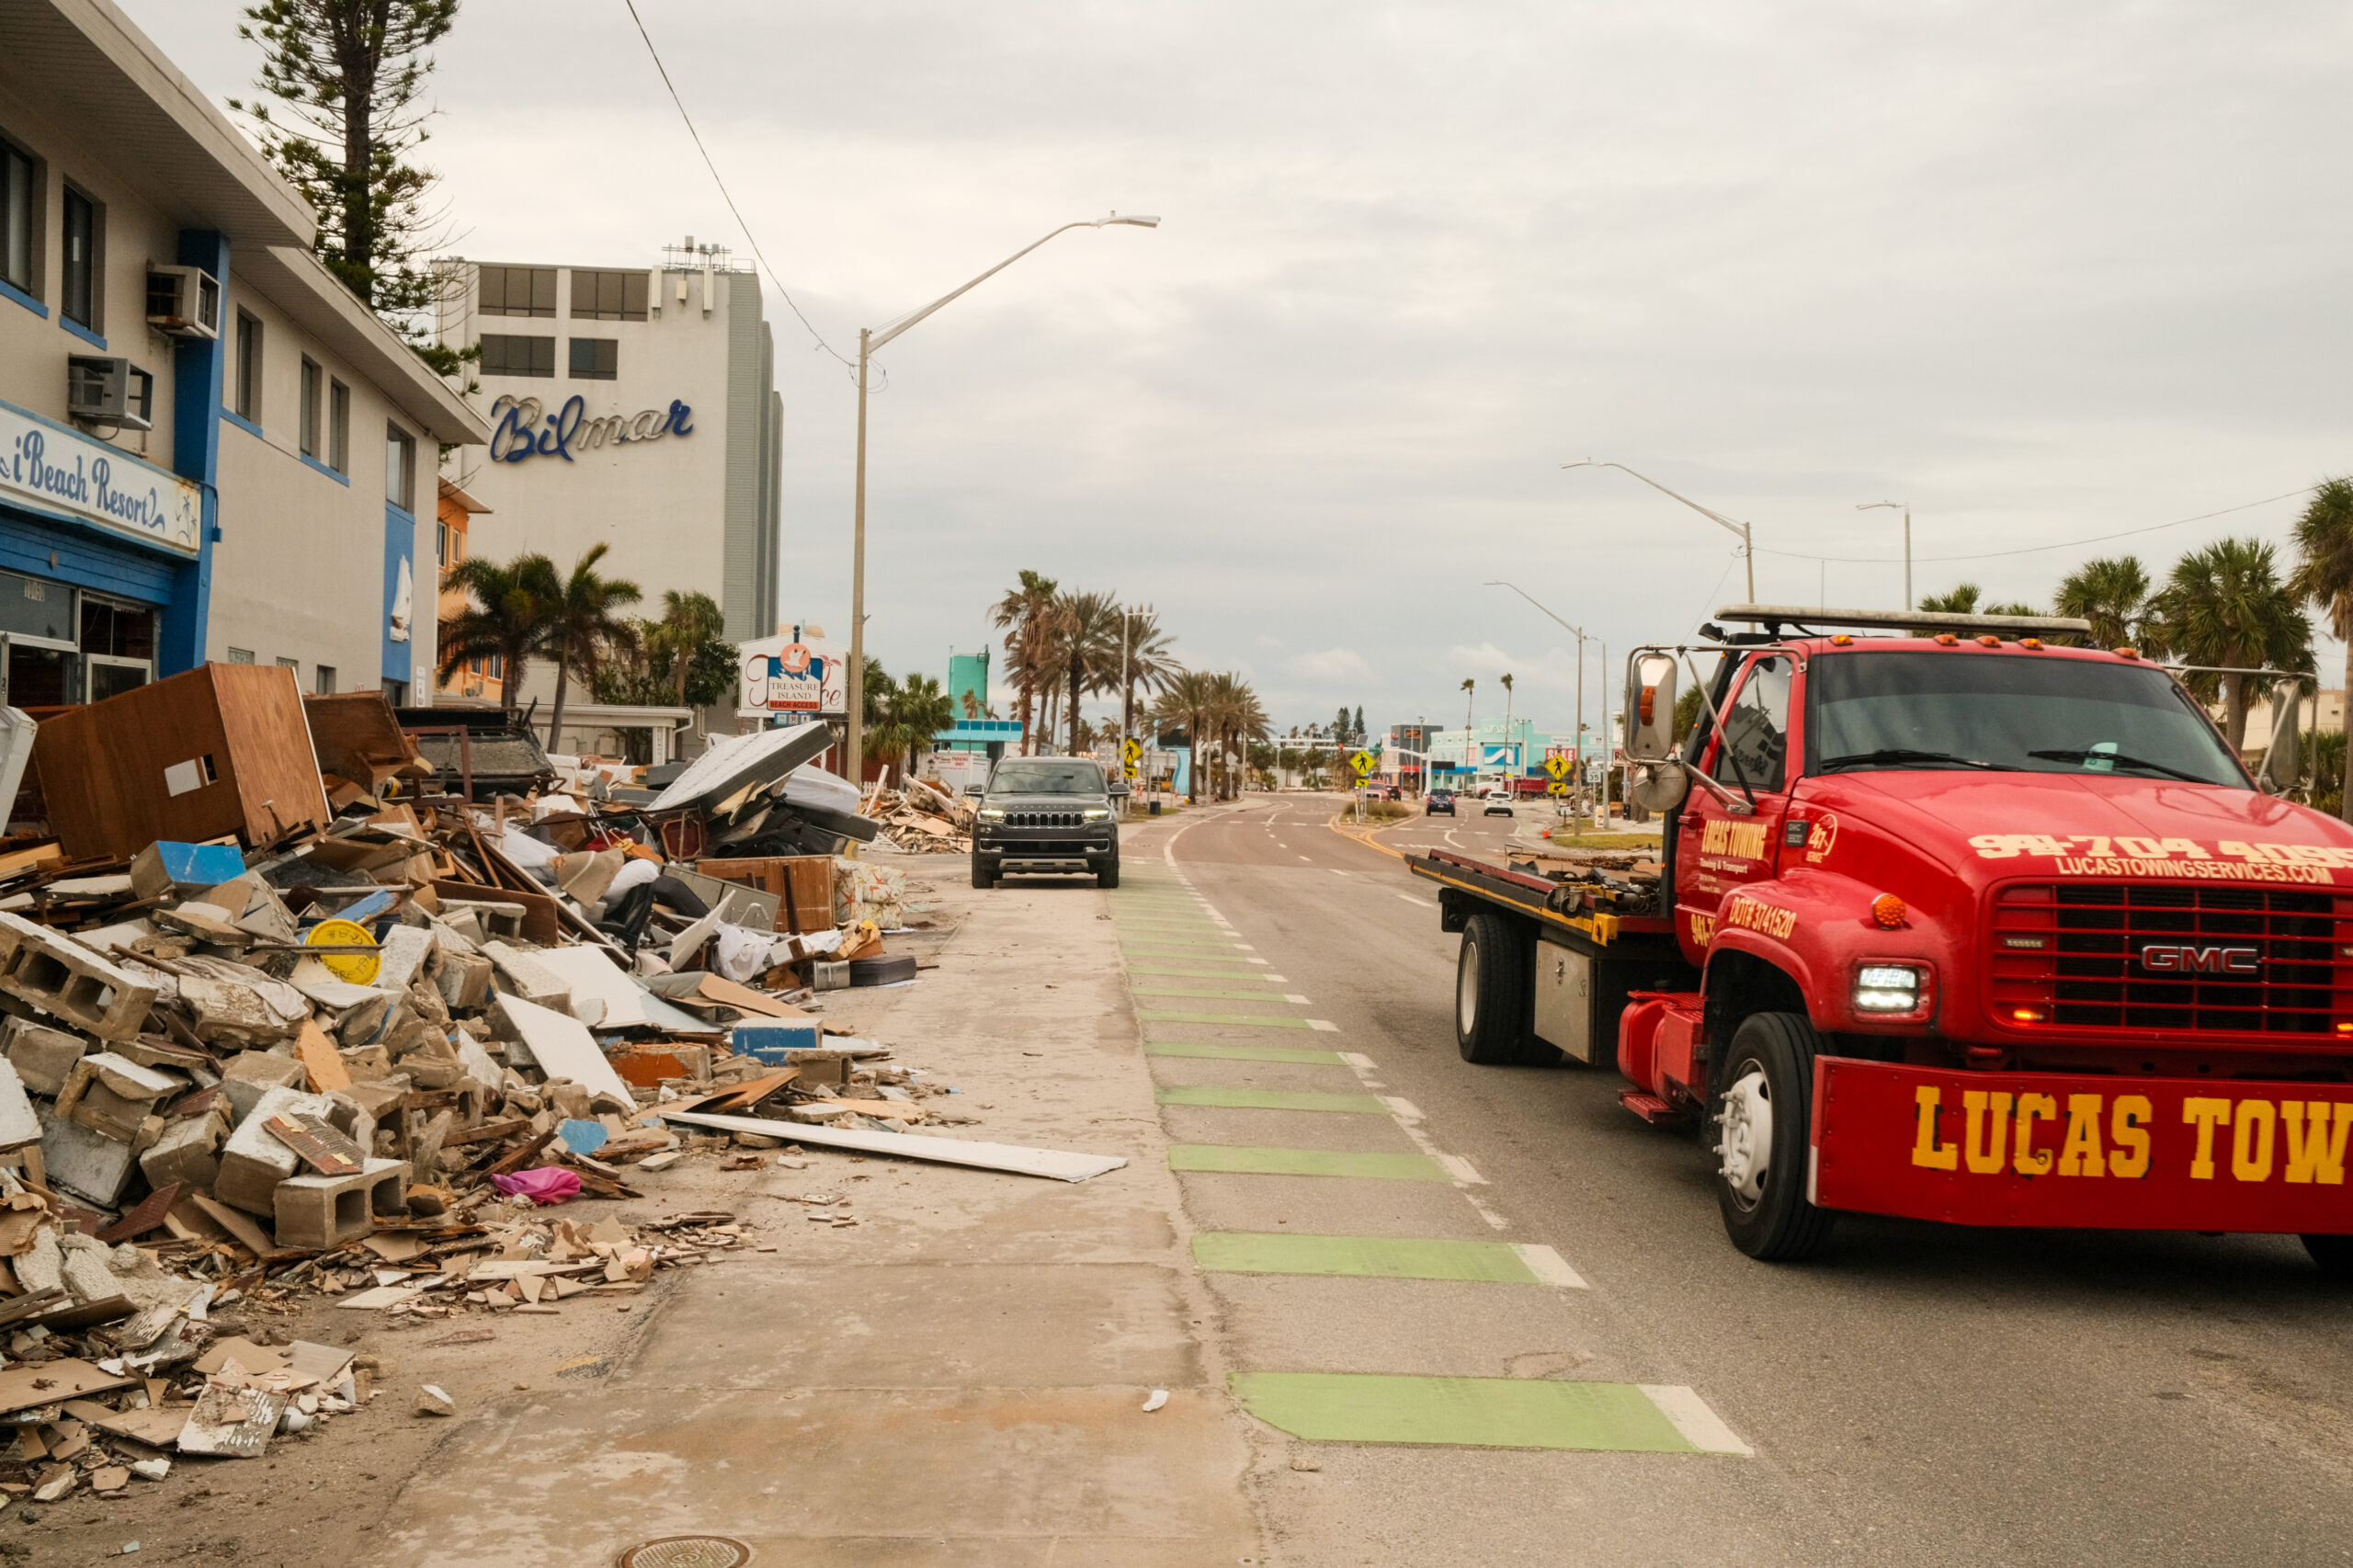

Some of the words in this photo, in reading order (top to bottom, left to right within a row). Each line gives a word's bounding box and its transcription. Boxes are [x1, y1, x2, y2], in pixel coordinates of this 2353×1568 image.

[490, 394, 694, 462] Bilmar
[23, 430, 89, 504] Beach
[92, 458, 165, 535] Resort
[770, 683, 819, 691] TREASURE
[1547, 749, 1574, 762] SLE
[1701, 820, 1731, 856] LUCAS
[1728, 822, 1767, 860] TOWING
[1968, 834, 2213, 858] 941-704
[2055, 858, 2335, 884] LUCASTOWINGSERVICES.COM
[1752, 903, 1797, 939] 3741520
[2142, 945, 2258, 973] GMC
[1911, 1085, 2153, 1178] LUCAS
